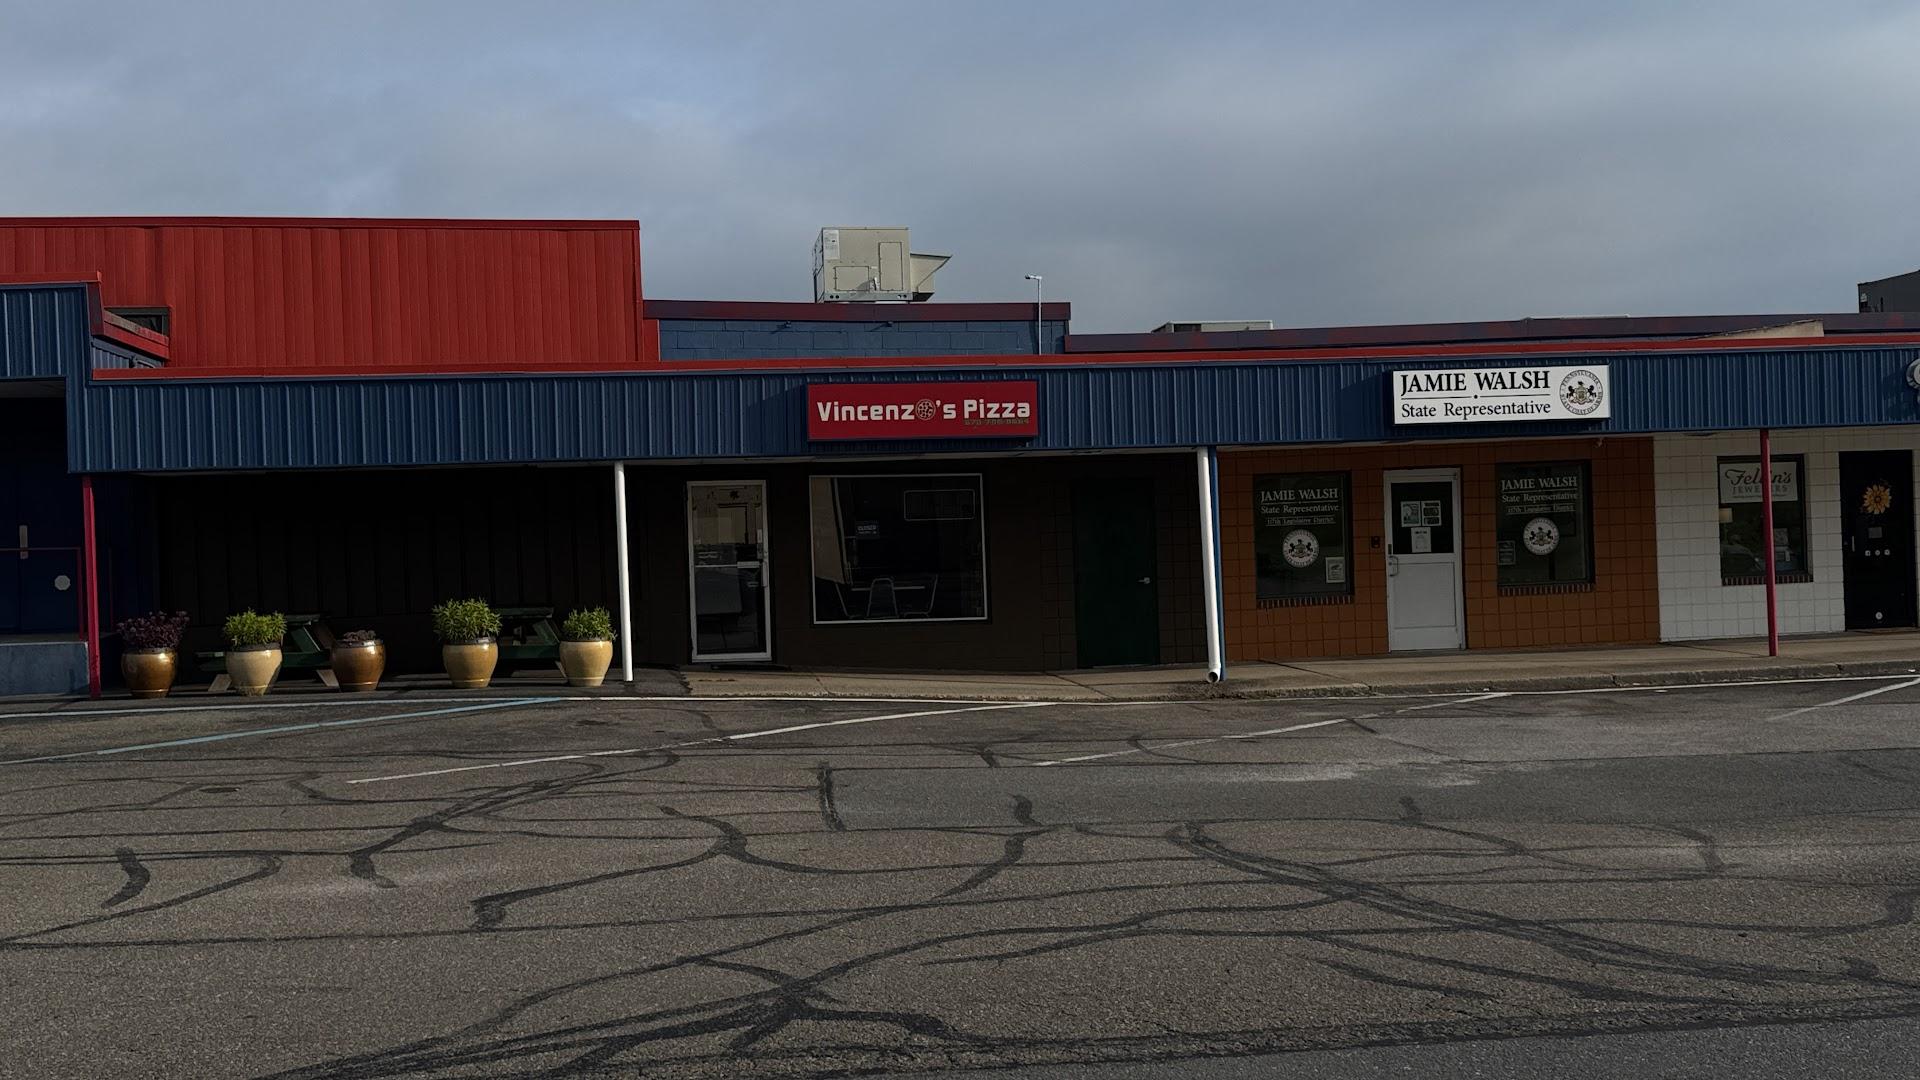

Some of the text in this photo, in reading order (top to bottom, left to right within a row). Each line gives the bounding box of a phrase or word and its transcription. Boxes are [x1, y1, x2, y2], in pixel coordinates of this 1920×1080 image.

[1400, 371, 1551, 396] JAMIE WALSH
[963, 398, 1031, 419] Pizza
[1401, 400, 1551, 420] State Representative
[1501, 476, 1577, 491] JAMIE WALSH
[1725, 467, 1792, 486] Feln's
[1260, 488, 1339, 503] JAMIE WALSH
[1502, 492, 1577, 504] State Representative
[1260, 503, 1339, 515] State Representative
